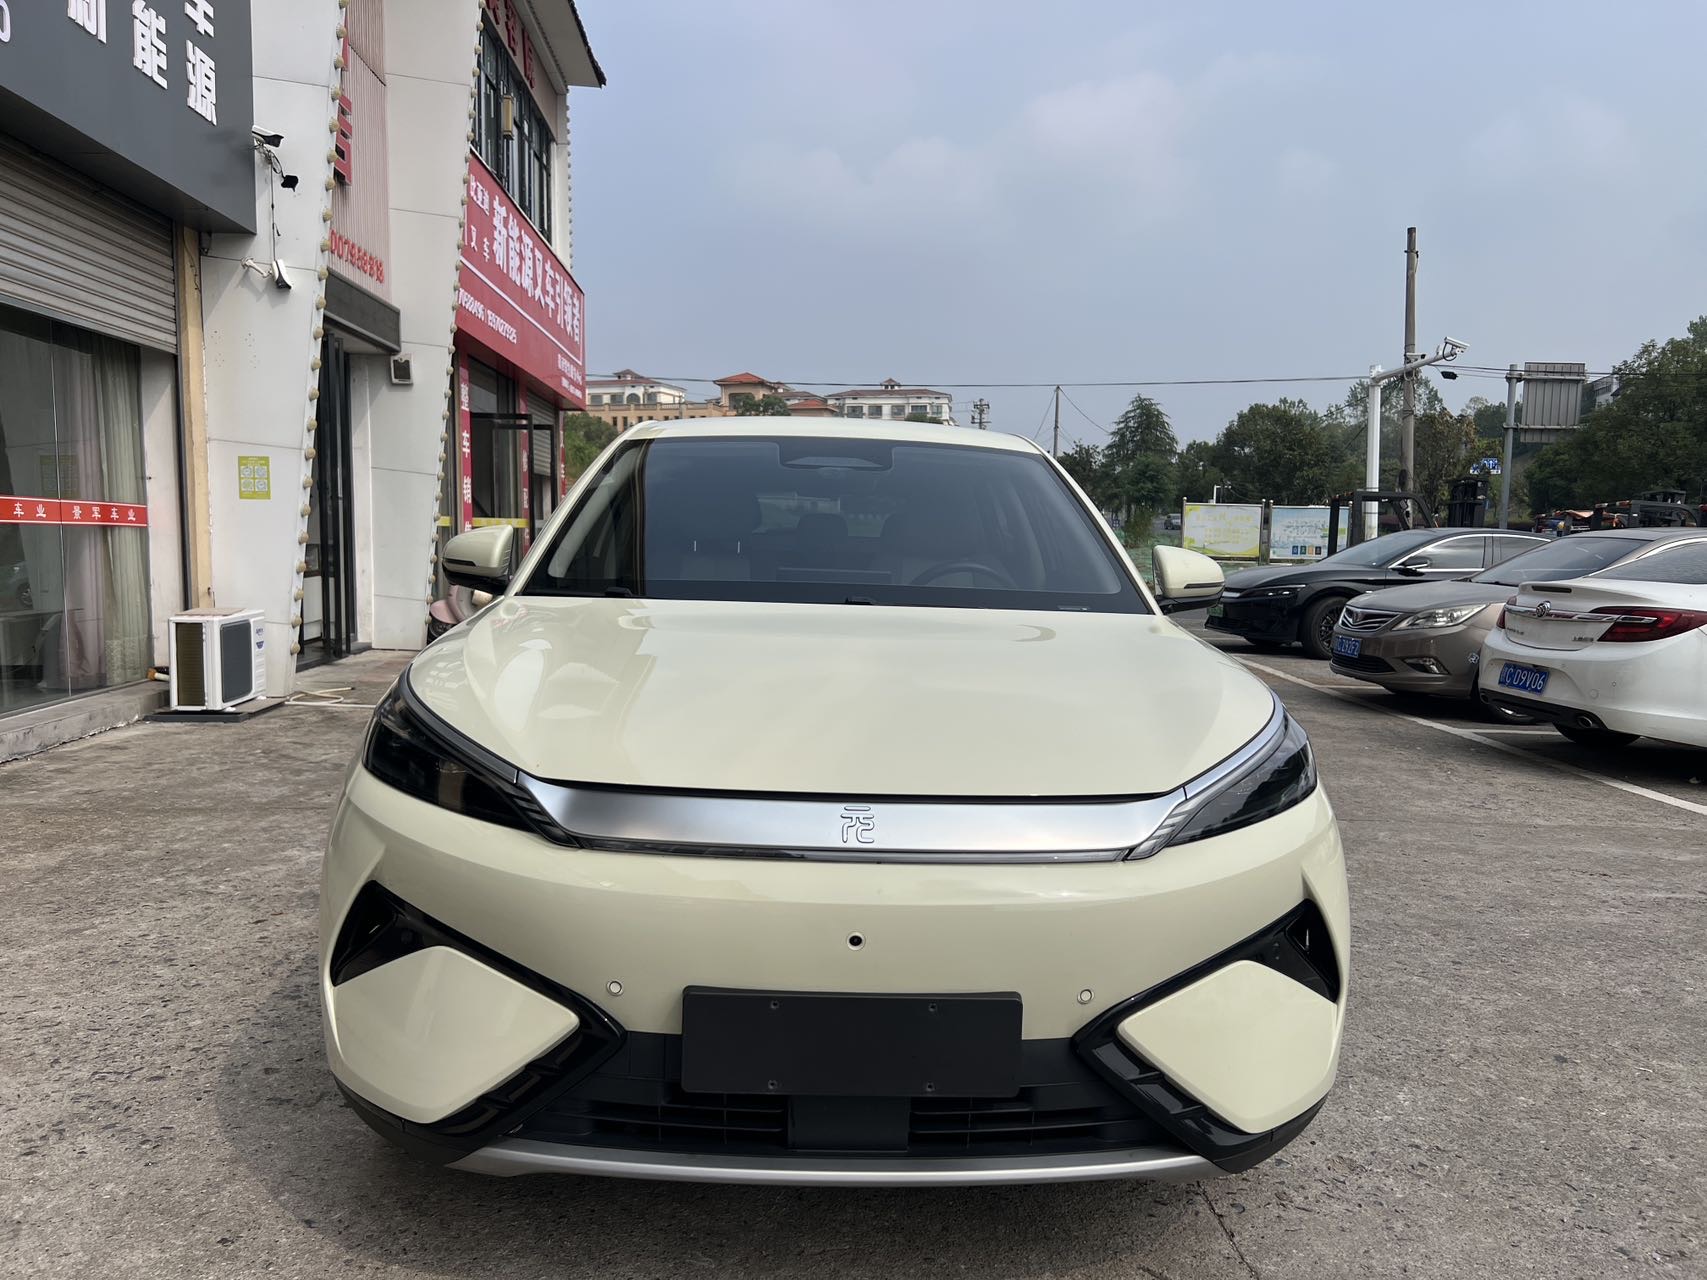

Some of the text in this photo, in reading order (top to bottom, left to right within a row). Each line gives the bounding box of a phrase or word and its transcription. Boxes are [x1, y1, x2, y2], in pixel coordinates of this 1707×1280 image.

[492, 195, 581, 344] 新能源叉车引领者
[13, 501, 48, 519] 车业
